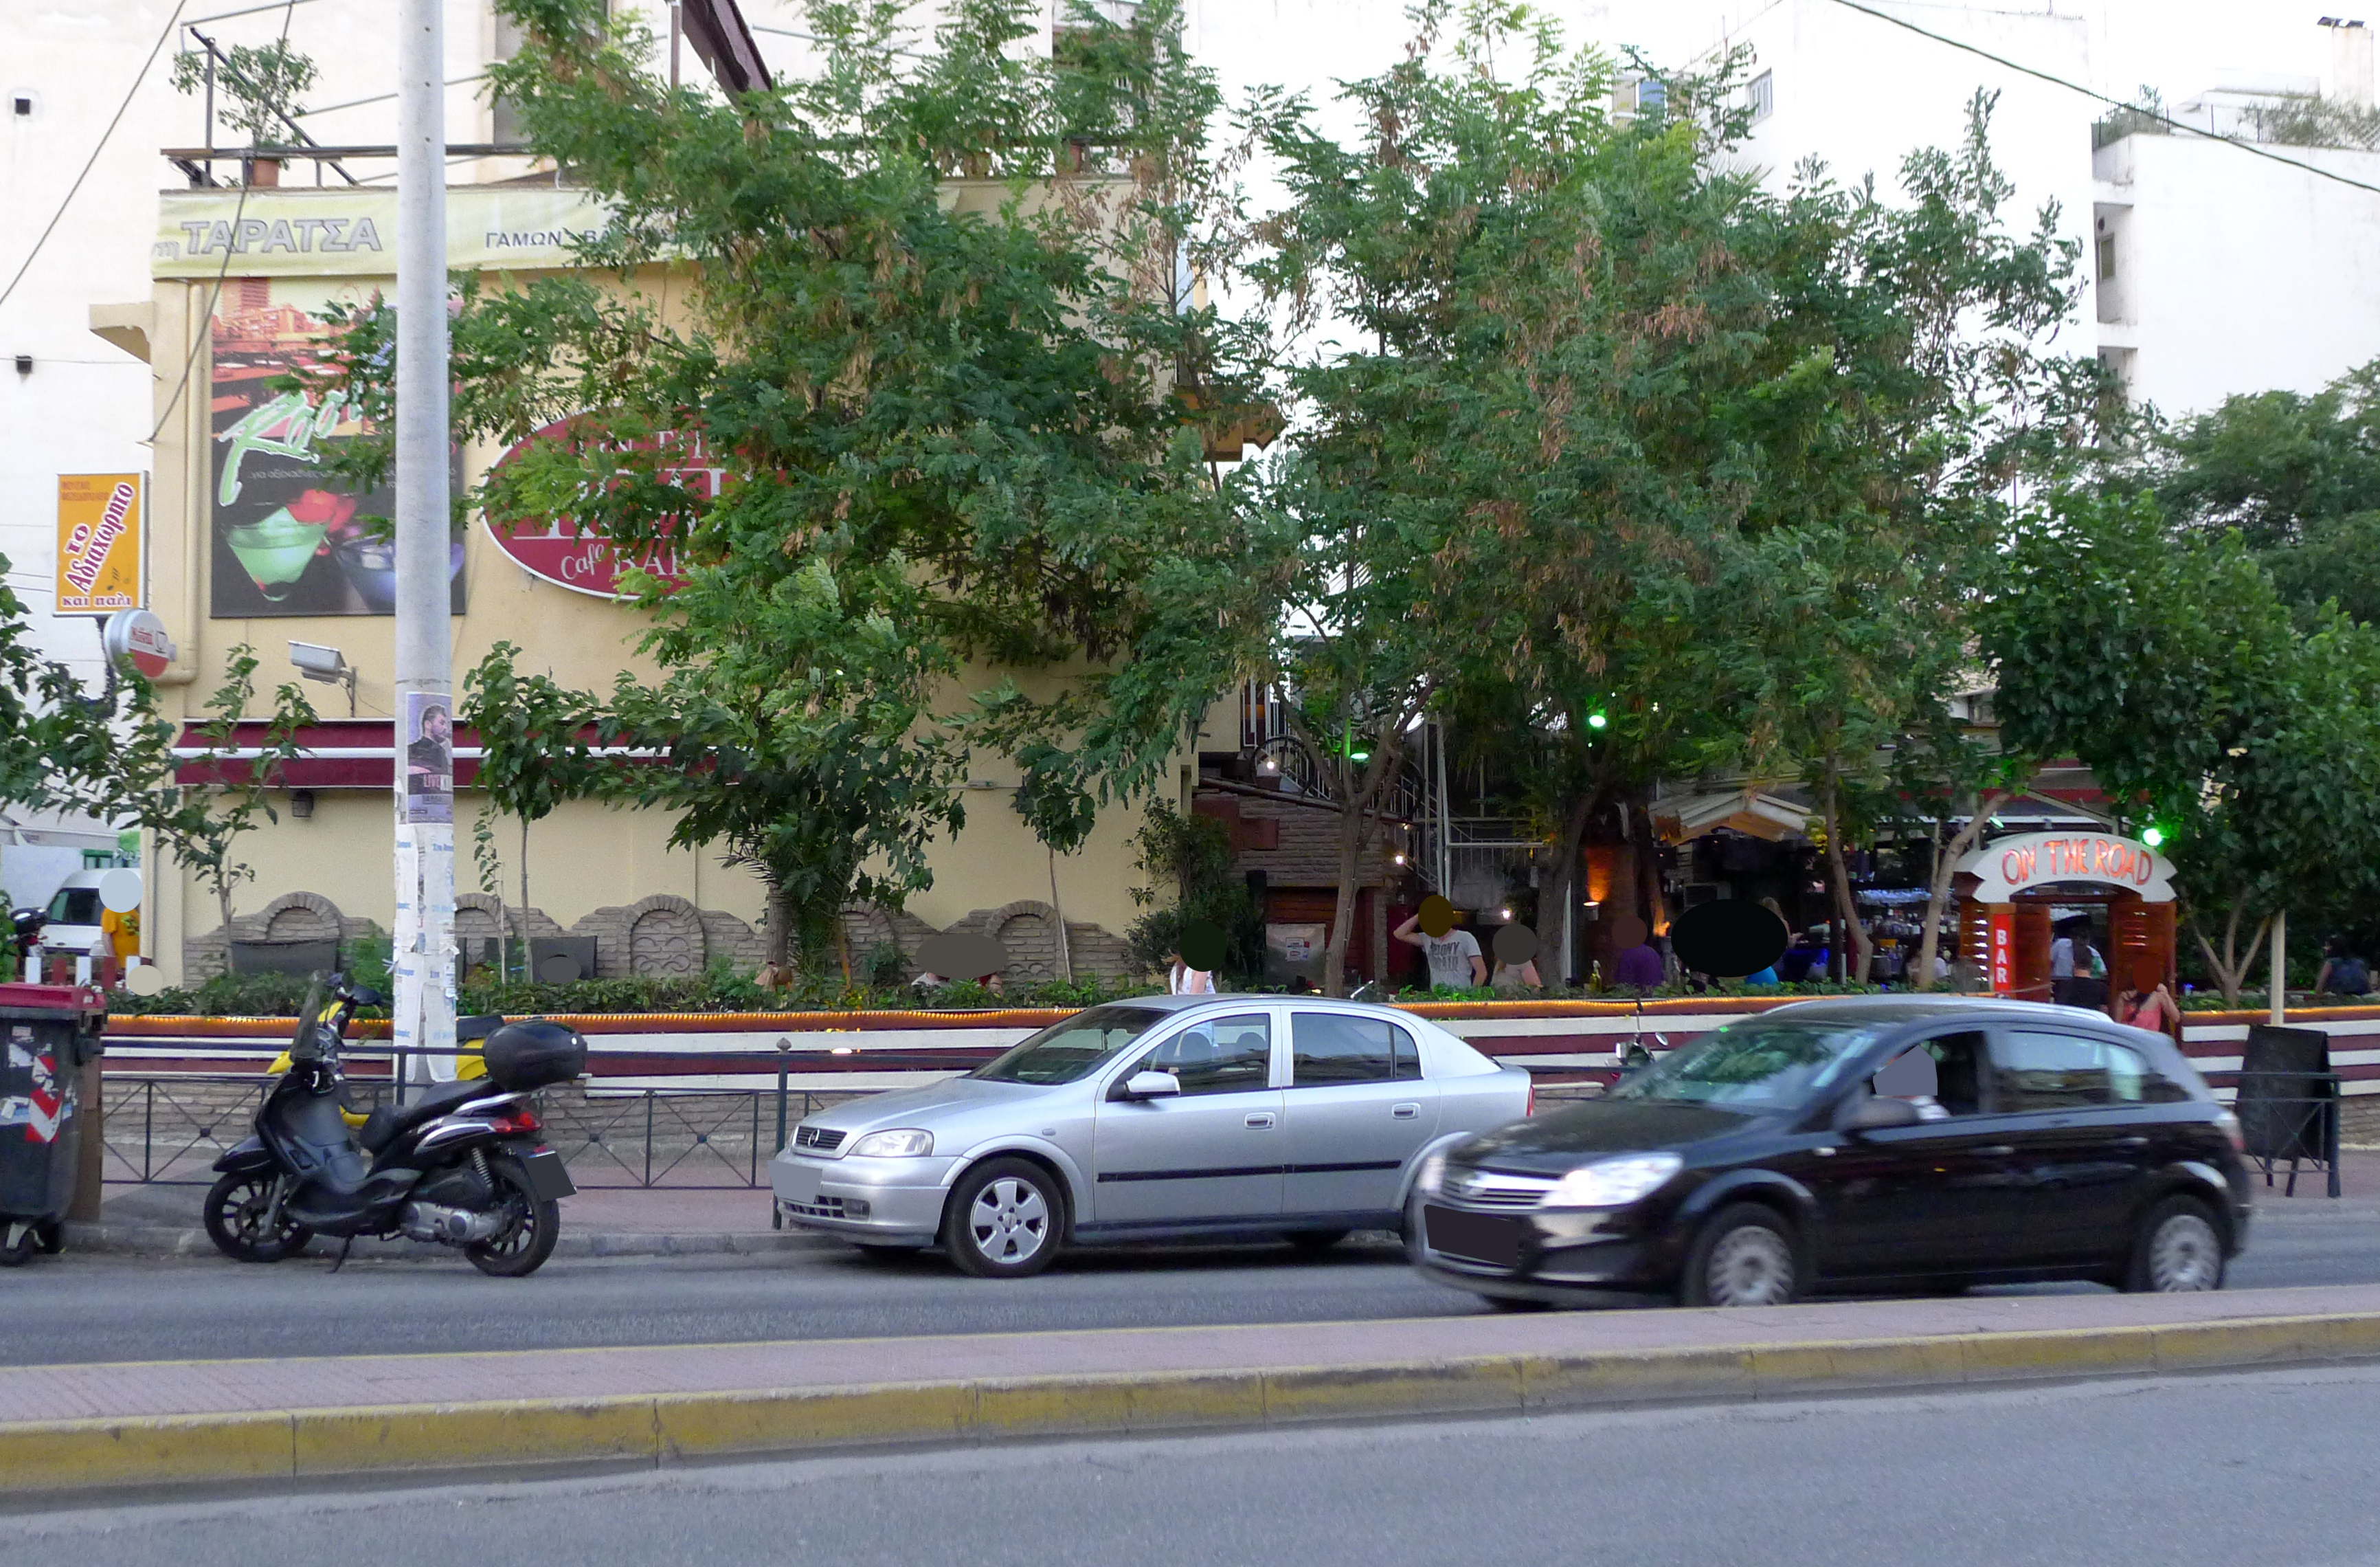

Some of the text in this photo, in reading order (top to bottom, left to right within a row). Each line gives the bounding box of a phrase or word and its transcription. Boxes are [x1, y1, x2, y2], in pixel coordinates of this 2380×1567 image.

[181, 216, 383, 255] ΤΑΡΑΤΣΑ
[485, 230, 562, 249] ΓΑΜΩΝ
[62, 597, 89, 606] και
[2001, 838, 2153, 885] ON THE ROAD
[1995, 929, 2008, 983] BAR
